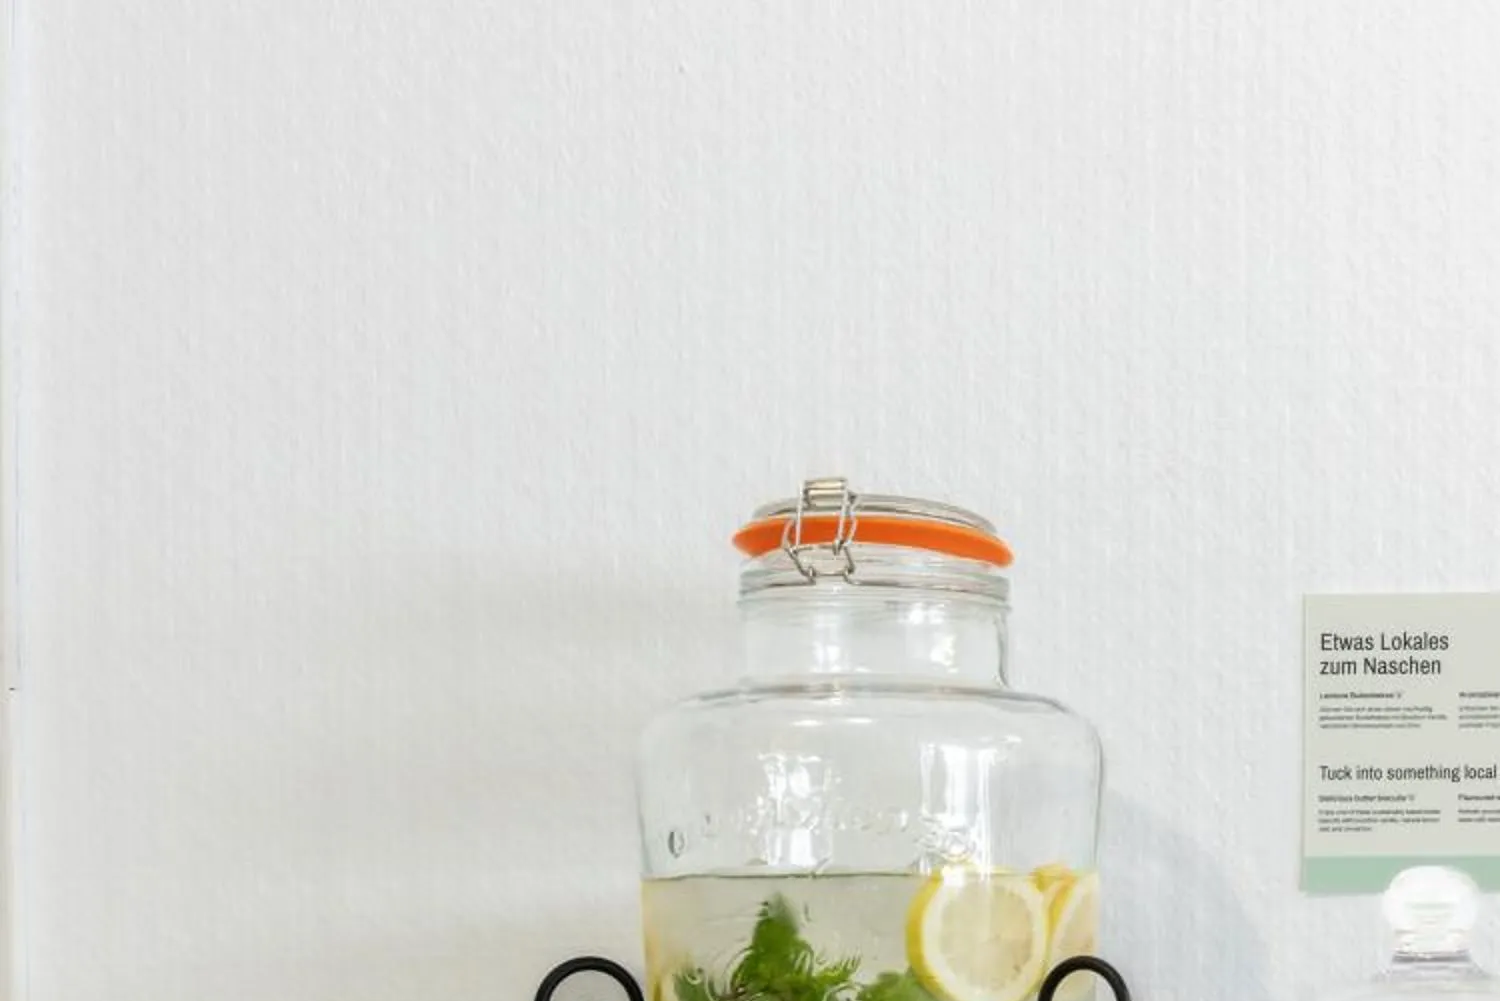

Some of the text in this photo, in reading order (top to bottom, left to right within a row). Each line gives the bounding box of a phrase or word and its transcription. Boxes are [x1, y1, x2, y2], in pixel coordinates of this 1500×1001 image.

[1320, 632, 1449, 651] Etwas Lokales
[1320, 656, 1442, 676] zum Naschen
[1319, 764, 1498, 783] Tuck into something local
